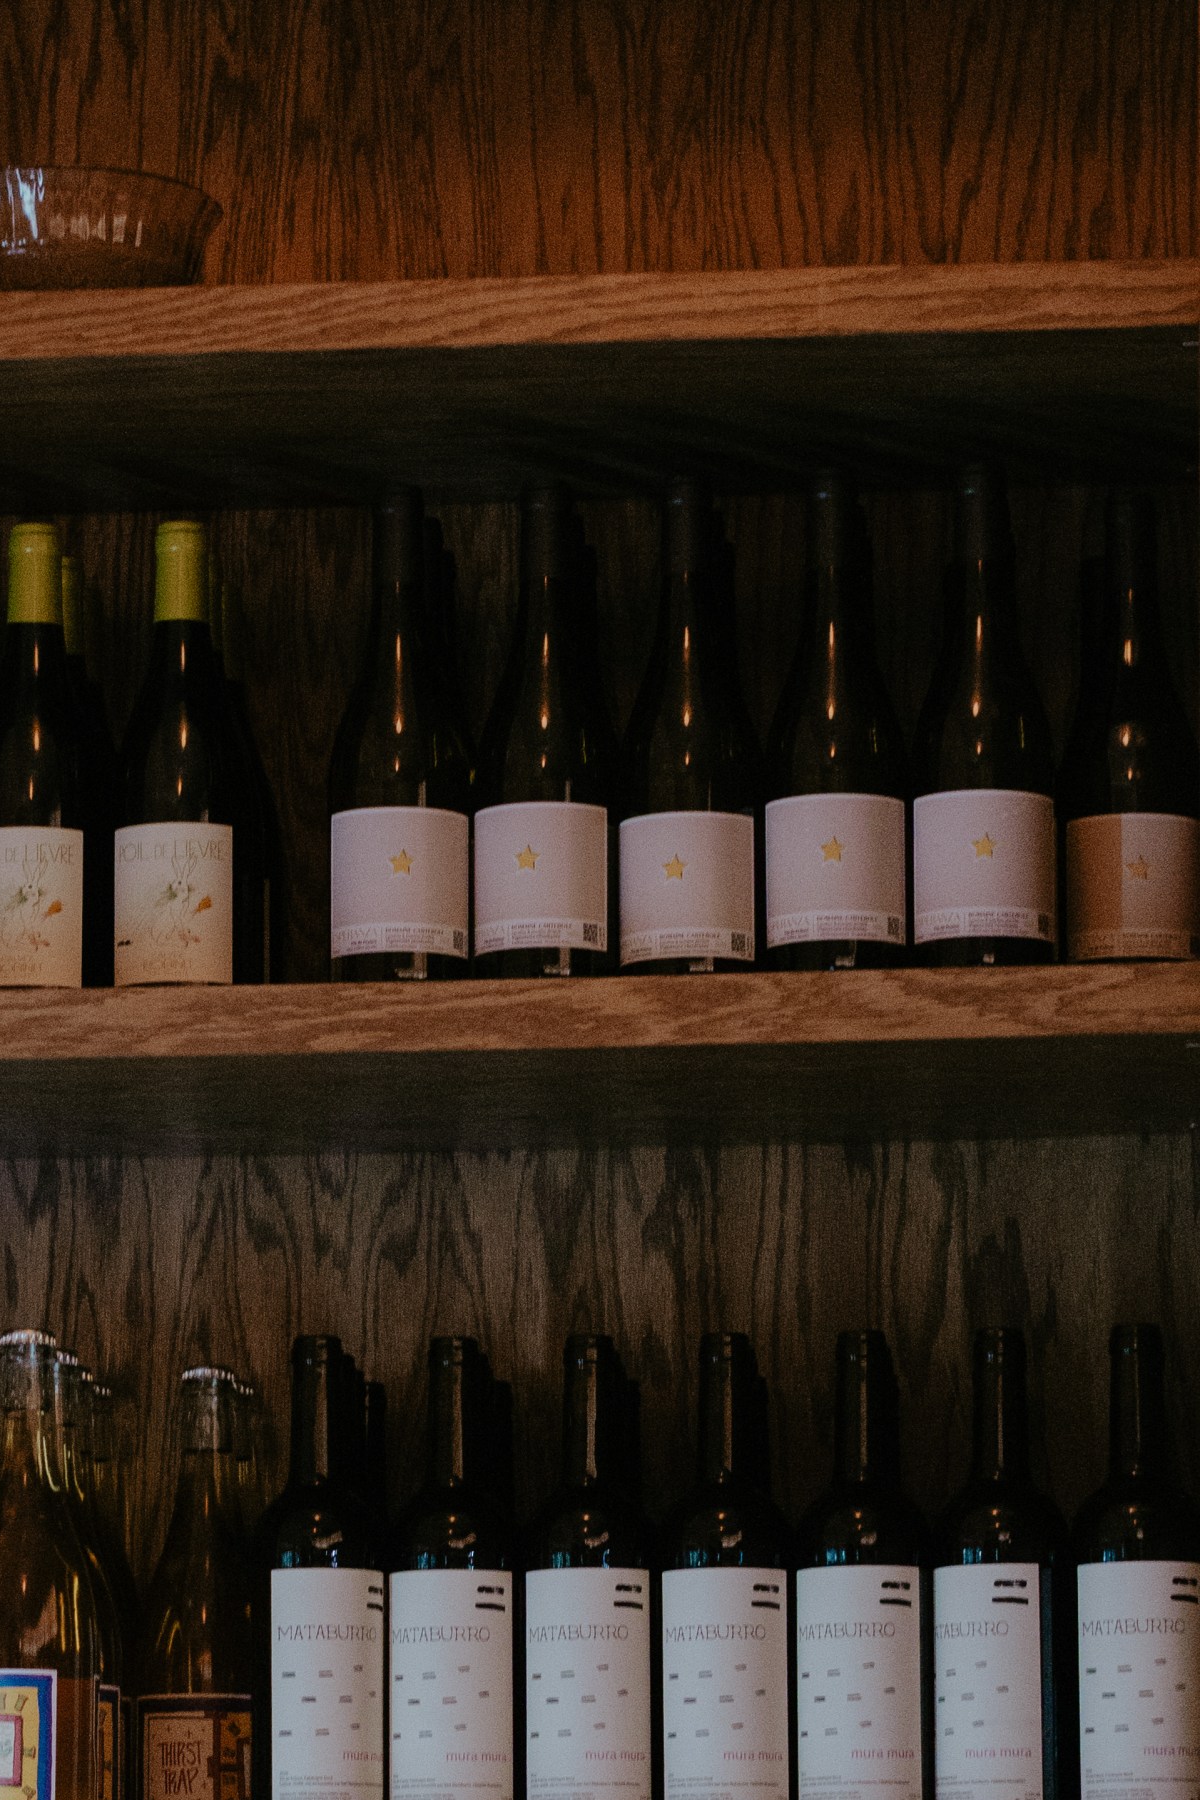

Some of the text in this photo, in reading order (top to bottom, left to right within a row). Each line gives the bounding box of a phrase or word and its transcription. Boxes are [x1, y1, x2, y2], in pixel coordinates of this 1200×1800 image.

[278, 1624, 378, 1641] MATABURRO
[392, 1625, 492, 1644] MATABURRO
[529, 1624, 629, 1644] MATABURRO
[666, 1624, 767, 1643] MATABURRO
[800, 1622, 897, 1641] MATABURRO
[1082, 1618, 1186, 1637] MATABURRO
[157, 1740, 205, 1767] THIRST
[162, 1768, 200, 1795] TRAP
